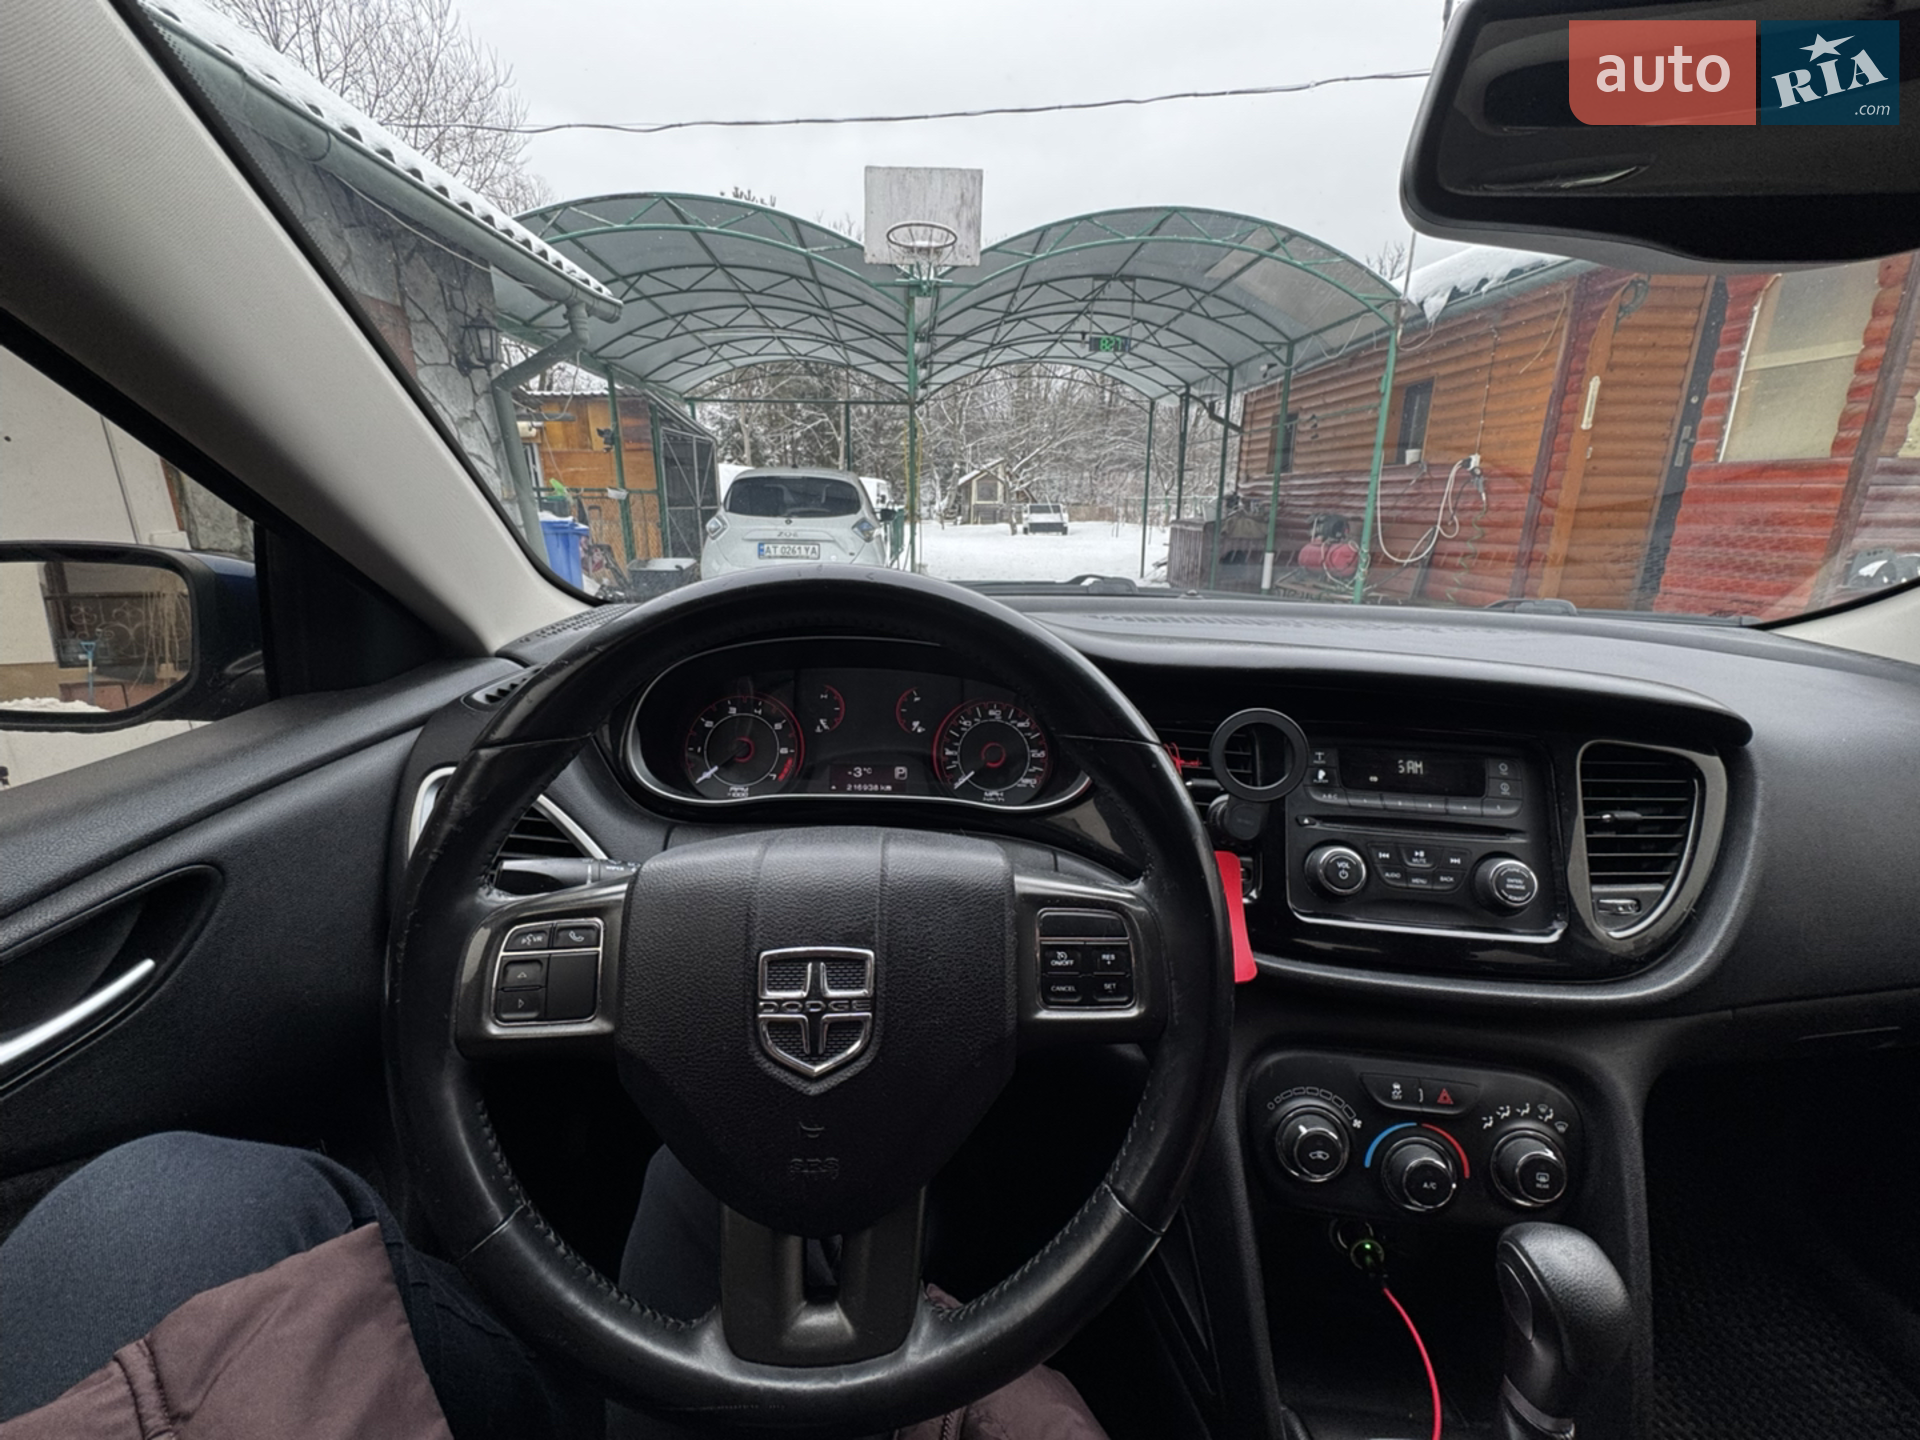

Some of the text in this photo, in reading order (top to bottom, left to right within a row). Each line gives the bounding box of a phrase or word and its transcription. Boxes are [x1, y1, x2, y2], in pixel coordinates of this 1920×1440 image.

[765, 545, 778, 555] AT
[1336, 861, 1350, 869] VOL
[759, 1000, 872, 1013] DODGE
[1423, 1182, 1437, 1190] A/C
